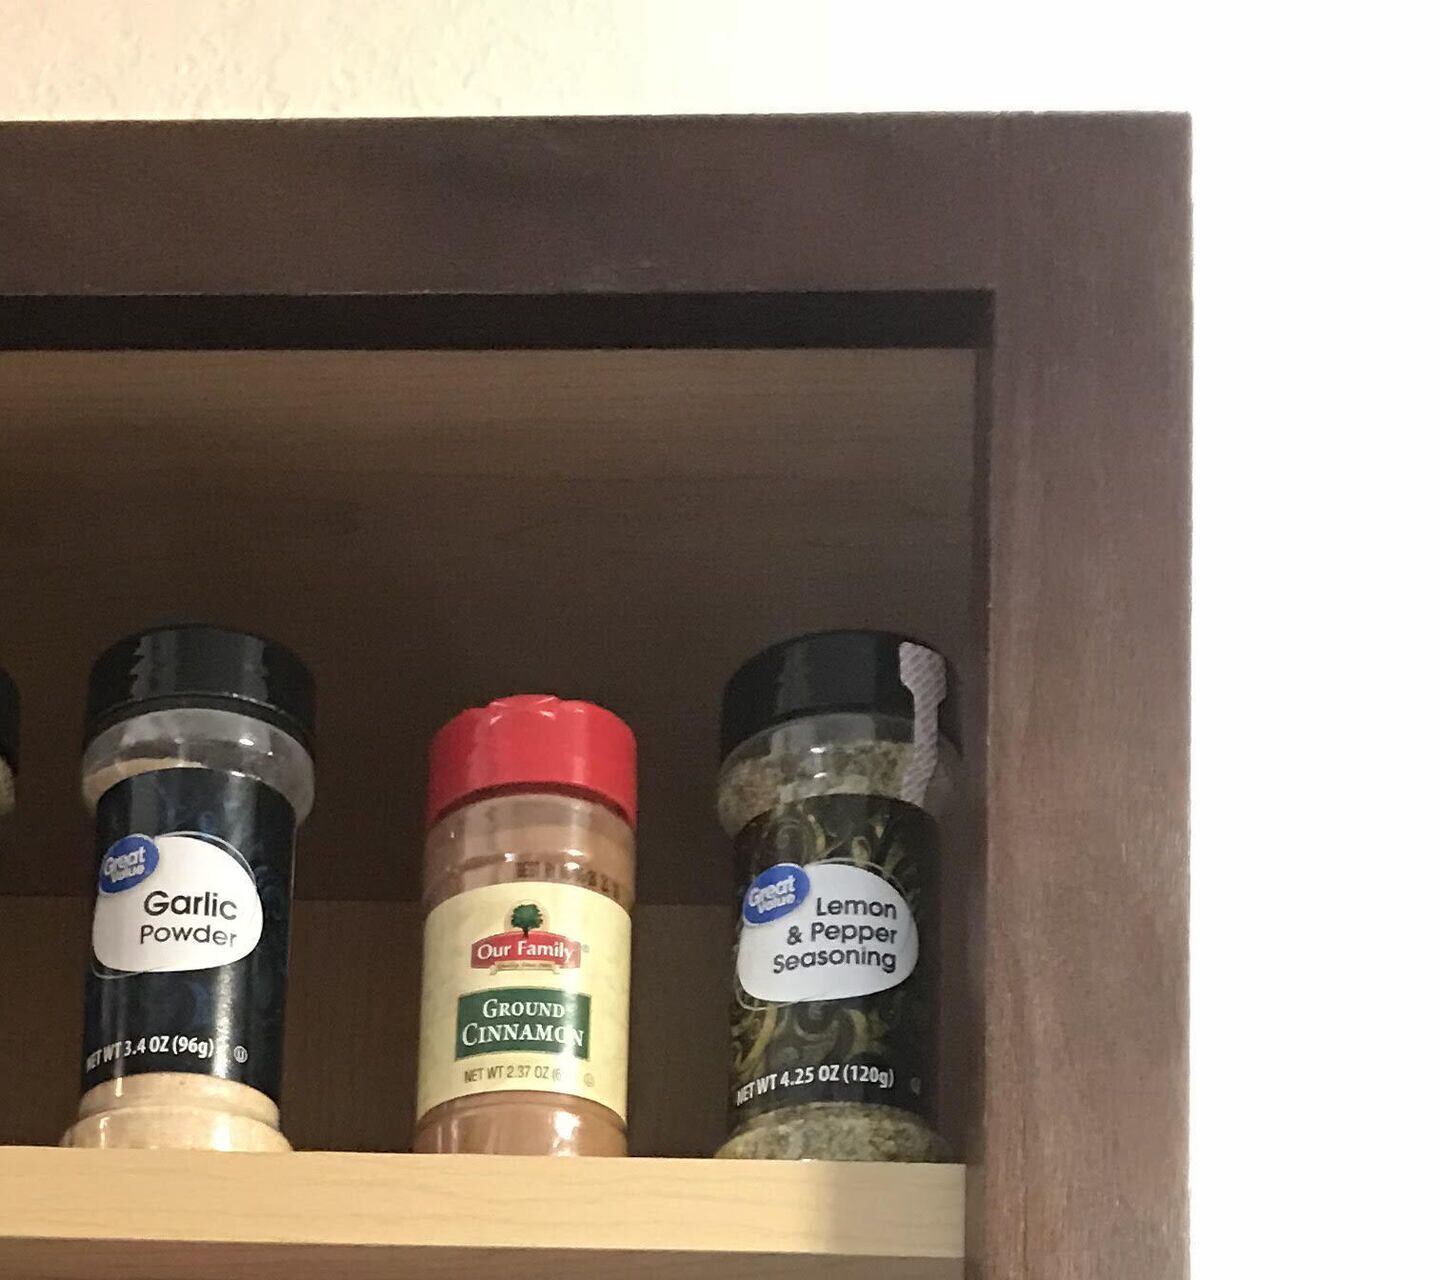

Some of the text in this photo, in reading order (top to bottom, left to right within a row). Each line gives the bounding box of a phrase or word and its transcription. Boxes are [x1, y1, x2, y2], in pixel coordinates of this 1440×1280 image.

[103, 846, 146, 876] Great
[748, 875, 796, 908] Great
[143, 890, 238, 921] Garlic
[816, 897, 898, 921] Lemon
[139, 924, 238, 948] Powder
[786, 921, 898, 945] & Pepper
[477, 940, 574, 962] Our Family
[773, 948, 898, 974] Seasoning
[483, 999, 566, 1019] GROUND
[461, 1022, 585, 1048] CINNAMON
[86, 1035, 215, 1074] NET WT 3.4 OZ (96g)
[464, 1067, 484, 1084] NET
[487, 1066, 504, 1081] WT
[506, 1065, 531, 1079] 2.37
[534, 1065, 549, 1080] OZ
[736, 1064, 895, 1107] NET WT 4.25 OZ (120g)
